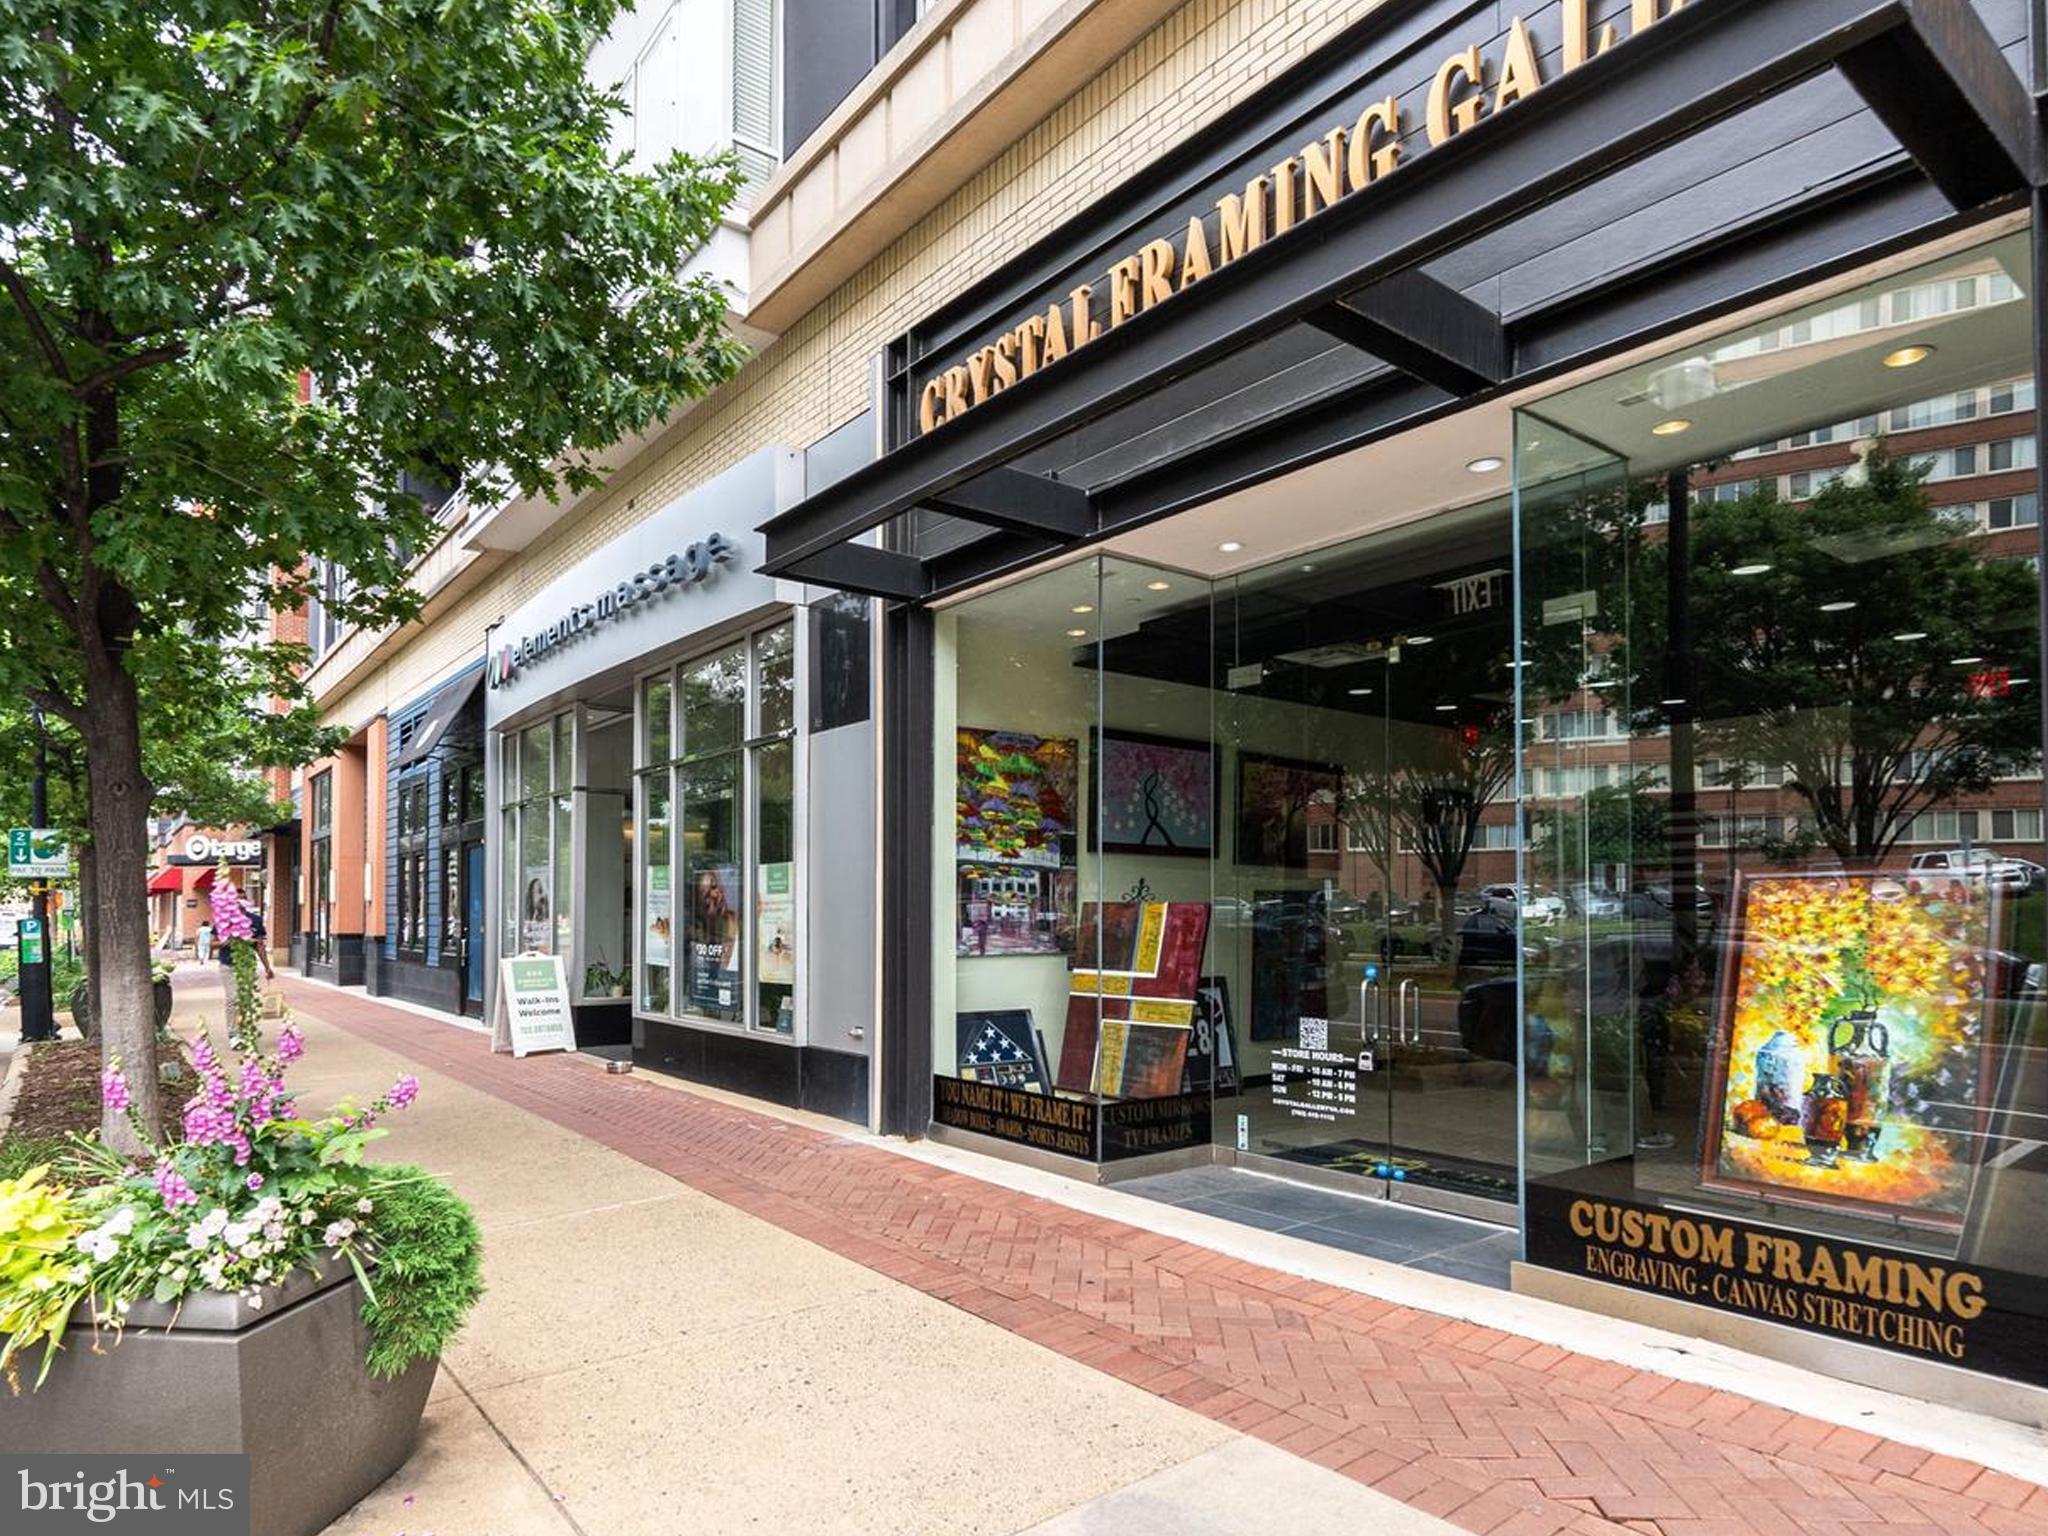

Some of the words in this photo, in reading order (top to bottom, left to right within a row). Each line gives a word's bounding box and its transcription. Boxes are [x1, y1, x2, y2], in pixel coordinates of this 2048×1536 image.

[920, 284, 1101, 434] CRYSTAL
[1108, 96, 1402, 329] FRAMING
[512, 603, 596, 667] elements
[596, 532, 735, 621] massage
[16, 831, 26, 840] 2
[211, 838, 262, 861] targe
[26, 921, 37, 932] P
[518, 1008, 561, 1017] Welcome
[1281, 1047, 1311, 1060] STORE
[1311, 1050, 1344, 1064] HOURS
[1344, 1069, 1356, 1079] PM
[1344, 1081, 1356, 1091] PM
[961, 1084, 991, 1110] NAME
[1010, 1091, 1028, 1116] WE
[1029, 1096, 1071, 1127] FRAME
[1344, 1093, 1356, 1104] PM
[1102, 1102, 1154, 1126] CUSTOM
[1028, 1123, 1056, 1145] SPORTS
[1056, 1129, 1091, 1155] JERSEYS
[1142, 1121, 1193, 1147] FRAMES
[1569, 1200, 1736, 1269] CUSTOM
[1745, 1231, 1987, 1320] FRAMING
[1585, 1244, 1698, 1296] ENGRAVING
[1712, 1272, 1798, 1320] CANVAS
[1803, 1293, 1966, 1359] STRETCHING
